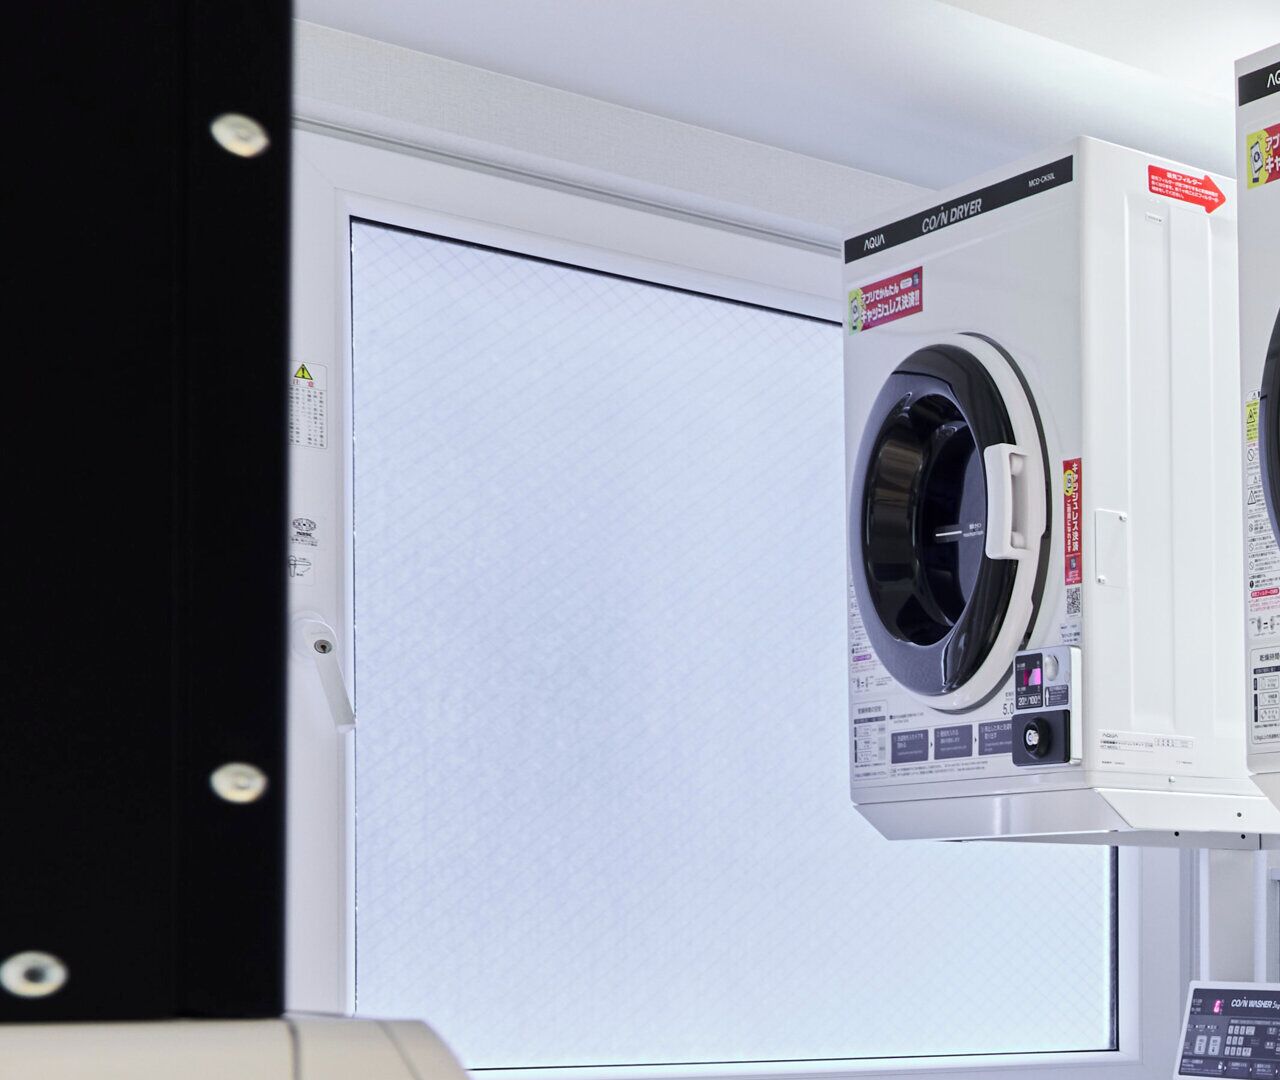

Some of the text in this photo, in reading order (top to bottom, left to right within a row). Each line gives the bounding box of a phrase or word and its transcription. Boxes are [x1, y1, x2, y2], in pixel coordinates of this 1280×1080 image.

[864, 234, 885, 251] AQUA
[950, 198, 982, 222] DRYER
[1249, 1000, 1272, 1008] WASHER
